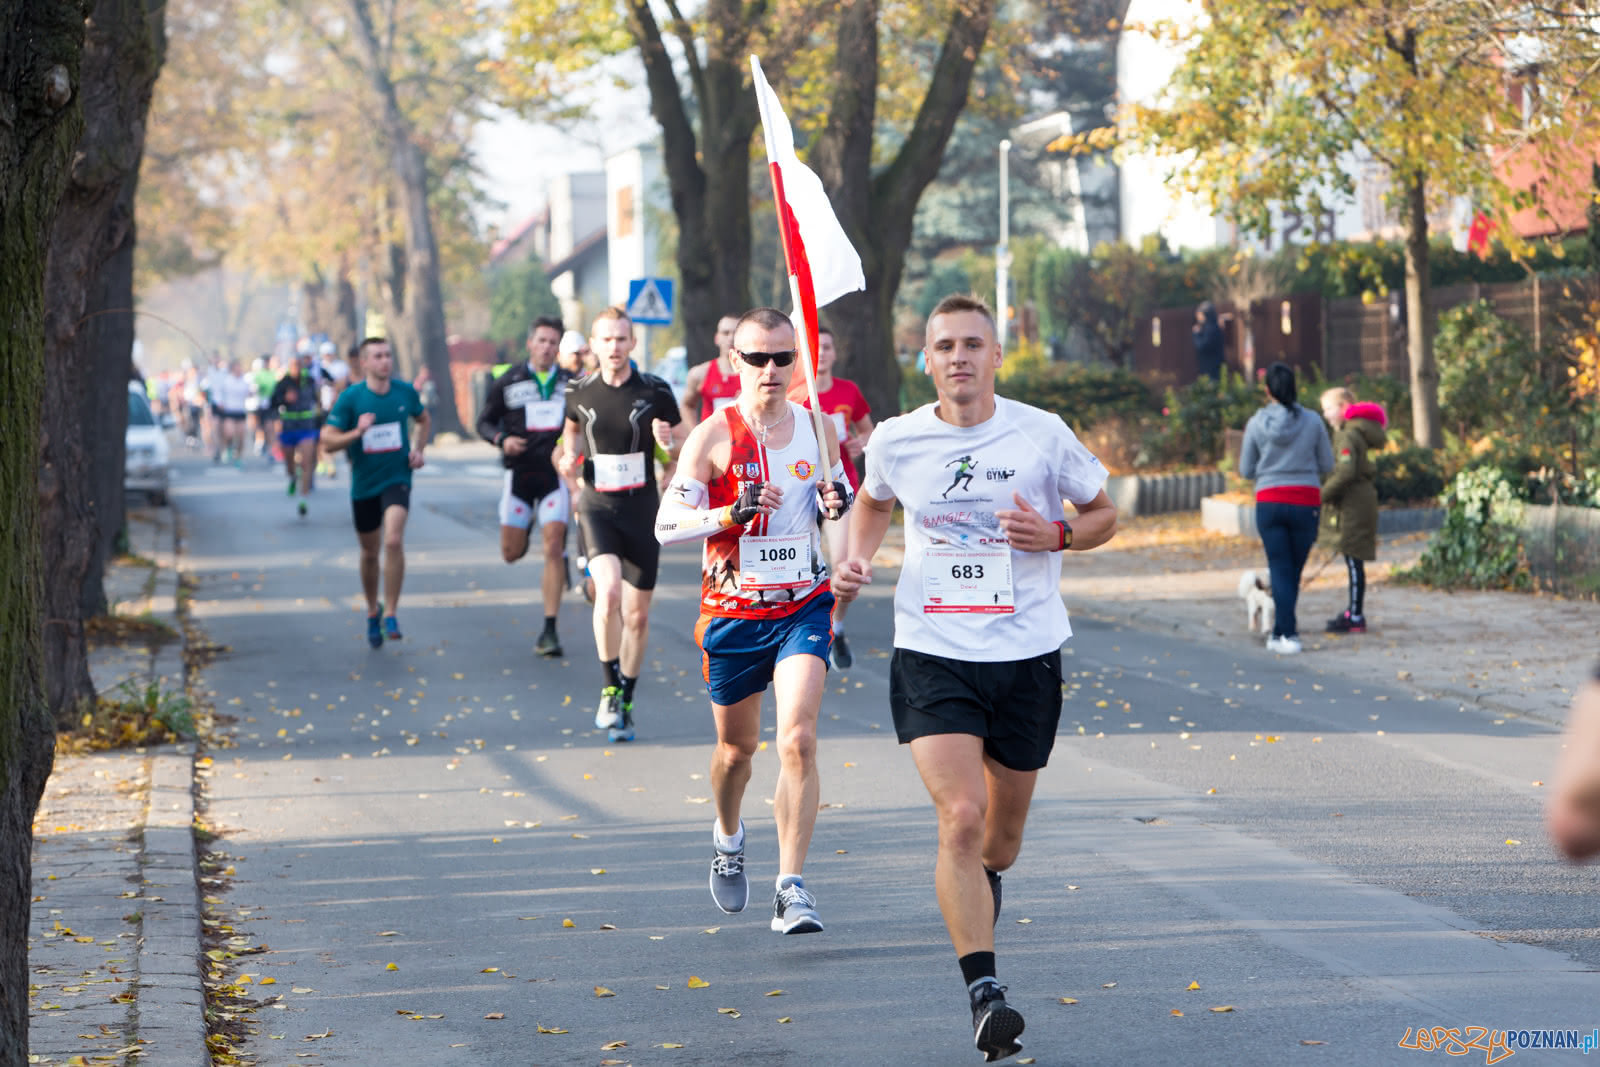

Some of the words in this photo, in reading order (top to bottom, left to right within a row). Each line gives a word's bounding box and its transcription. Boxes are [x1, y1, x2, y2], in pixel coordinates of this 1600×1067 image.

[986, 470, 1006, 480] GYM
[759, 547, 797, 562] 1080
[951, 564, 984, 579] 683
